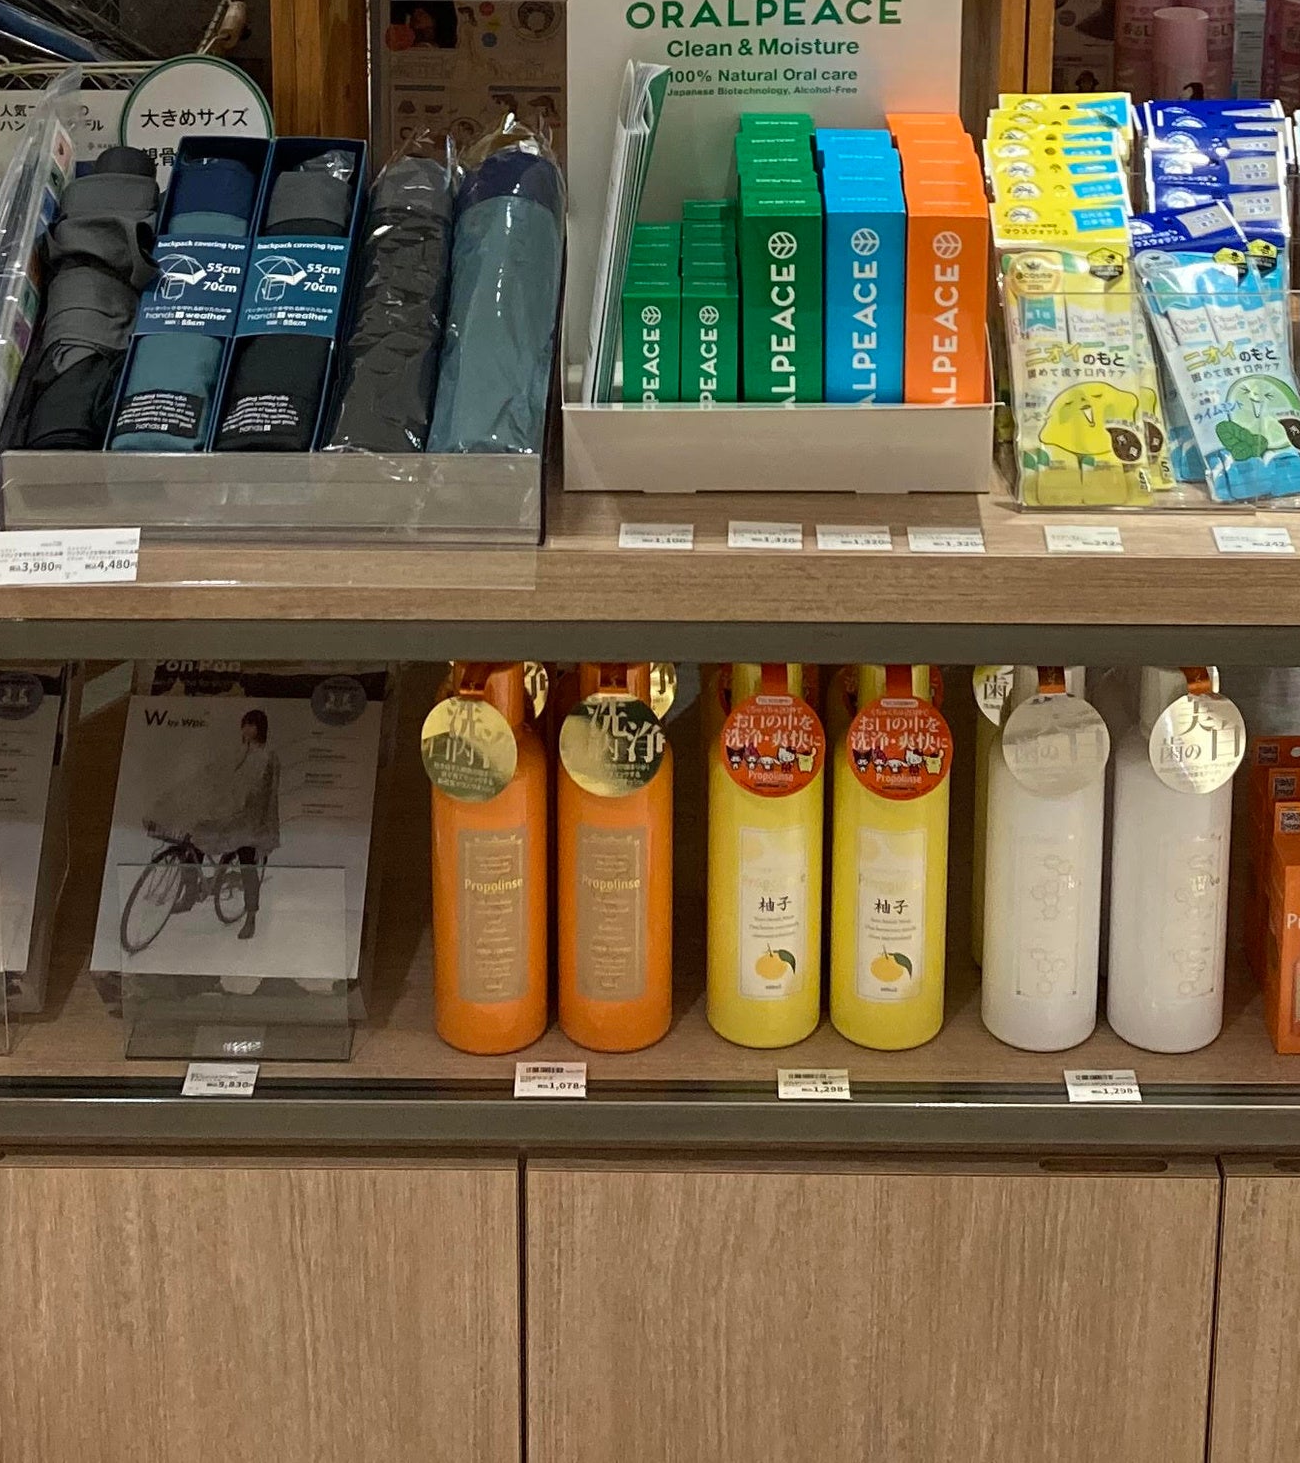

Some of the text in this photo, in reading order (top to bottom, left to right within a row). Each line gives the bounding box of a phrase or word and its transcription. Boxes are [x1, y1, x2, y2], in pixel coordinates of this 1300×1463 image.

[667, 38, 859, 58] Clean & Moisture
[668, 68, 858, 83] 100% Natural Oral care
[141, 107, 249, 128] 大きめサイズ
[206, 262, 241, 275] 55cm
[769, 264, 797, 407] LPEACE
[642, 328, 661, 404] PEACE
[731, 715, 814, 733] お口の中を
[758, 896, 793, 915] 柚子
